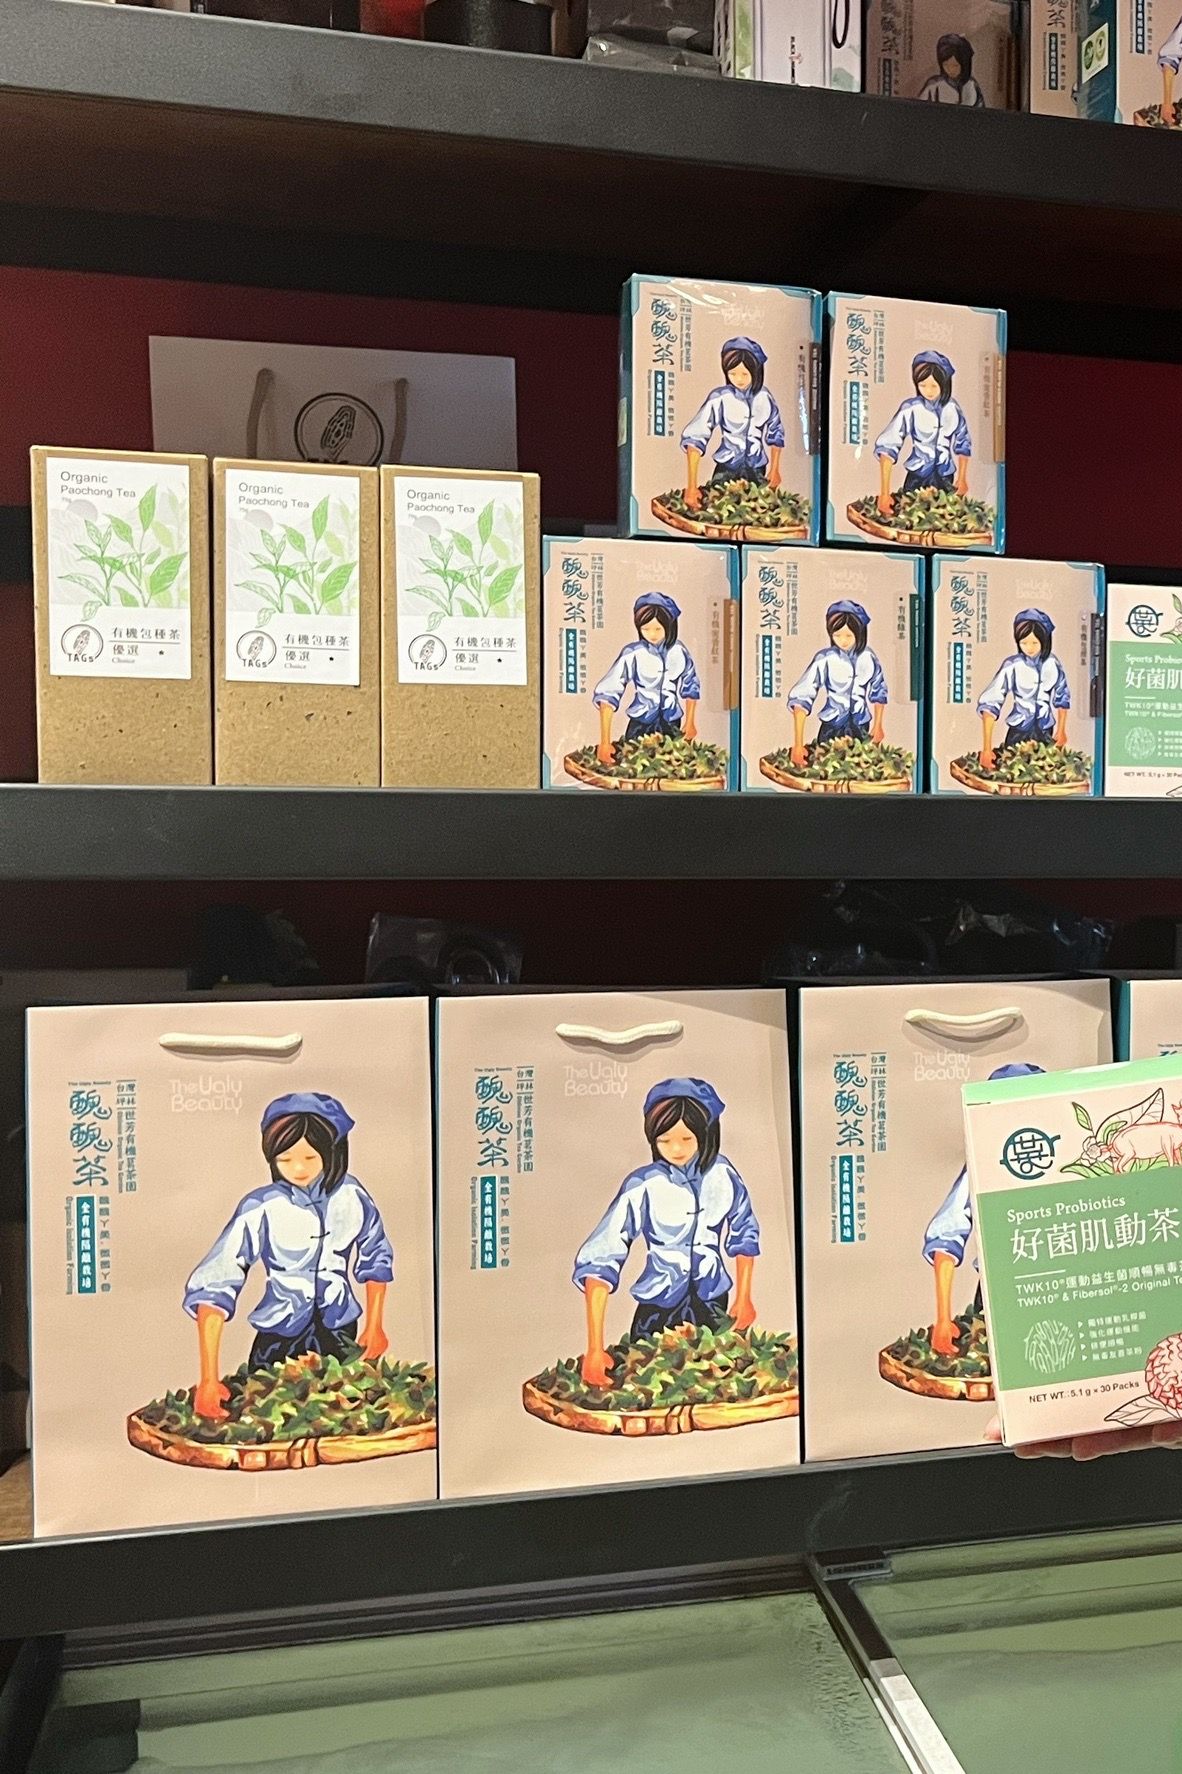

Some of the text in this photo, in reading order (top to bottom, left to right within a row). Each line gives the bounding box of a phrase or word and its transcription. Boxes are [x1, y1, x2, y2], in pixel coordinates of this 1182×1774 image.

[60, 471, 108, 484] Organic
[61, 485, 136, 498] Paochong Tea
[239, 482, 284, 495] Organic
[407, 489, 450, 501] Organic
[238, 496, 309, 508] Paochong Tea
[407, 503, 475, 514] Paochong Tea
[113, 627, 180, 640] 有機包種茶
[285, 634, 349, 646] 有機包種茶
[455, 637, 516, 648] 有機包種茶
[113, 644, 139, 656] 優選
[285, 650, 310, 661] 優選
[455, 653, 479, 663] 優選
[1125, 654, 1153, 665] Sports
[936, 1049, 970, 1066] Ugly
[590, 1061, 628, 1080] Ugly
[200, 1075, 242, 1097] Ugly
[565, 1079, 628, 1099] Beauty
[171, 1095, 242, 1114] Beauty
[1007, 1196, 1126, 1225] Sports Probiotics
[1010, 1208, 1180, 1264] 好菌肌動茶
[1062, 1292, 1069, 1302] &
[1131, 1277, 1171, 1292] Original
[1029, 1393, 1047, 1403] NET
[1100, 1384, 1111, 1393] 30
[1113, 1381, 1140, 1391] Packs
